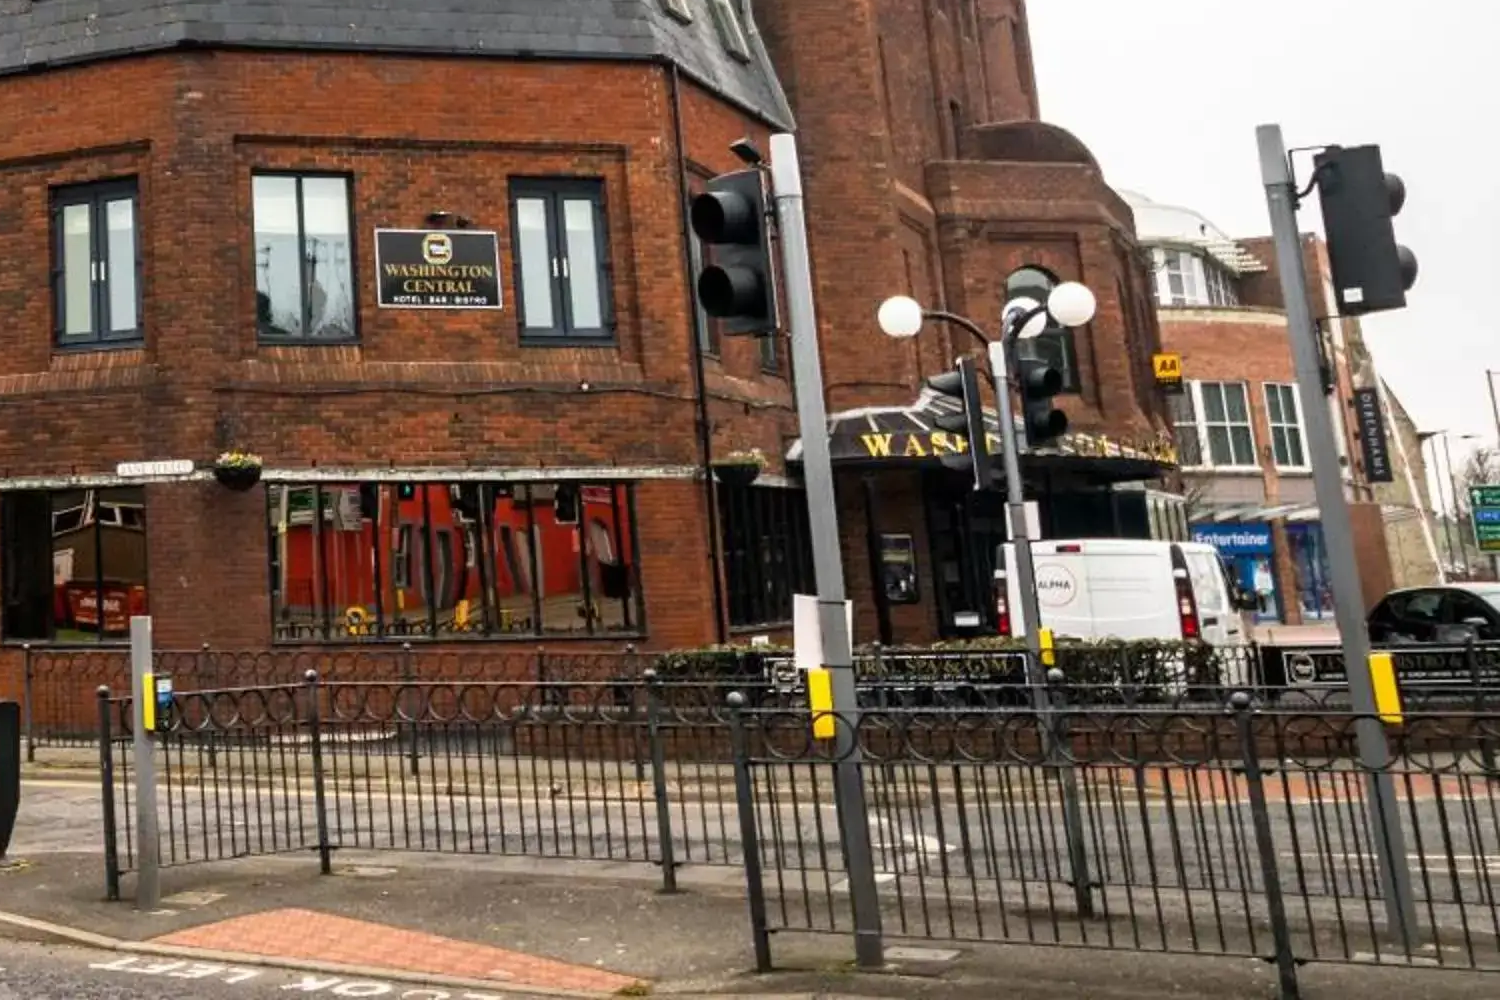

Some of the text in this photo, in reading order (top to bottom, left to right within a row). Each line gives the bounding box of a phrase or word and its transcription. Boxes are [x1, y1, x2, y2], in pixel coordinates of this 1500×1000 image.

[385, 263, 493, 278] WASHINGTON
[403, 280, 476, 293] CENTRAL
[393, 295, 421, 304] HOTEL
[454, 295, 488, 305] BISTRO
[1159, 359, 1177, 372] AA
[1361, 392, 1385, 476] DEBENHAMS
[1195, 531, 1269, 547] Entertainer
[1038, 579, 1071, 590] ALPHA
[88, 956, 262, 984] LEFT
